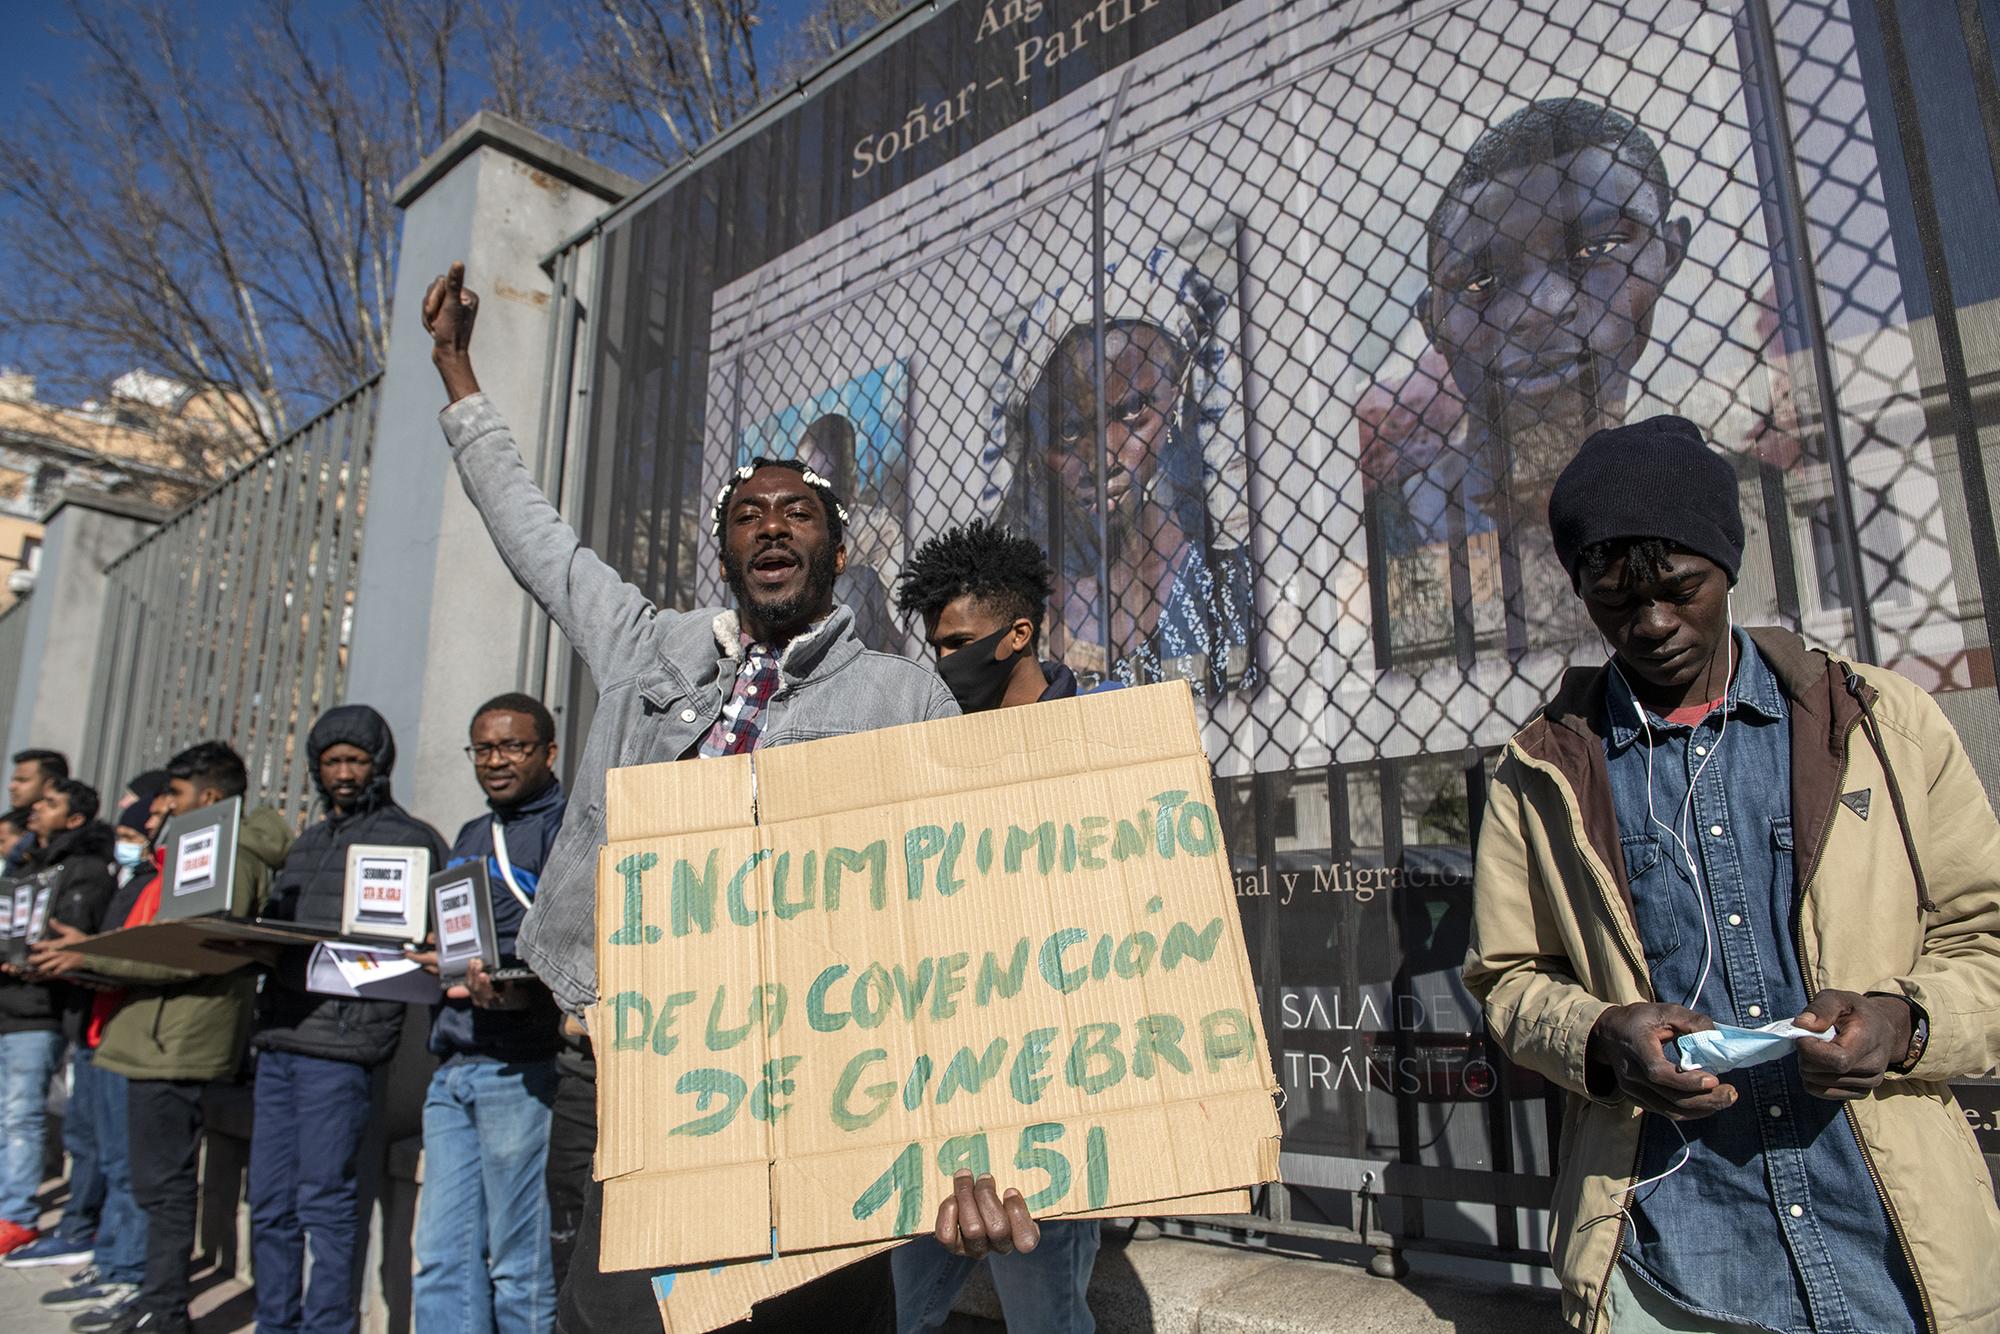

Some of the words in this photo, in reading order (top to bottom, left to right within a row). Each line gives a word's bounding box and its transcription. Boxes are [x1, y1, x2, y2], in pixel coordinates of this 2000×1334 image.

[852, 80, 979, 180] Soñar
[608, 790, 1219, 945] INCUMPLIMIENTO
[1280, 873, 1300, 905] y
[607, 990, 696, 1055] DE
[1282, 994, 1382, 1030] SALA
[1399, 995, 1456, 1032] DE
[668, 1055, 802, 1137] DE
[830, 1008, 1257, 1132] GINEBRA
[1285, 1046, 1498, 1098] TRÁNSITO
[852, 1122, 1109, 1237] 1951
